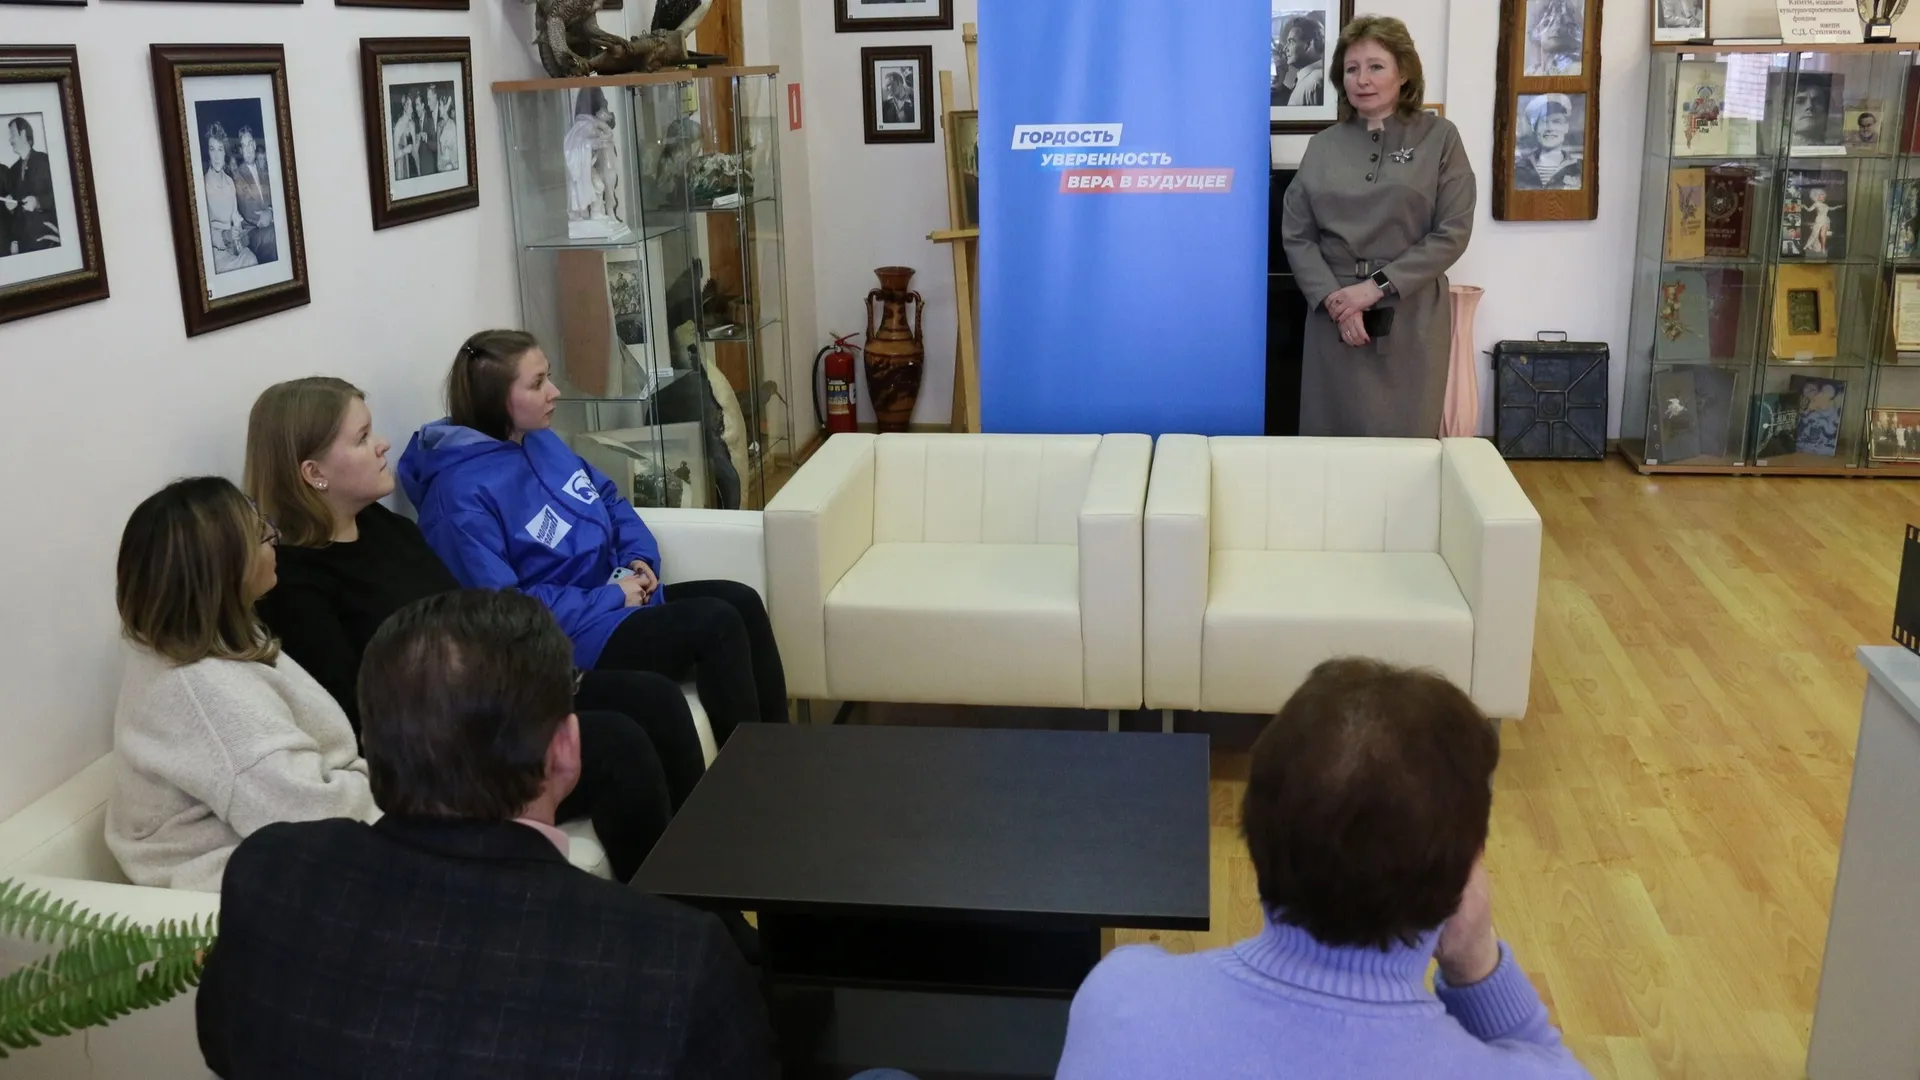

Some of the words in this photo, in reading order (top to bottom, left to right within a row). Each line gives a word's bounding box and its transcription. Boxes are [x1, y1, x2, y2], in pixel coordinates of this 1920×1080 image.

[1019, 130, 1114, 145] ГОРДОСТЬ
[1040, 152, 1172, 167] УВЕРЕННОСТЬ
[1067, 175, 1114, 189] ВЕРА
[1119, 175, 1132, 189] В
[1137, 174, 1227, 190] БУДУЩЕЕ
